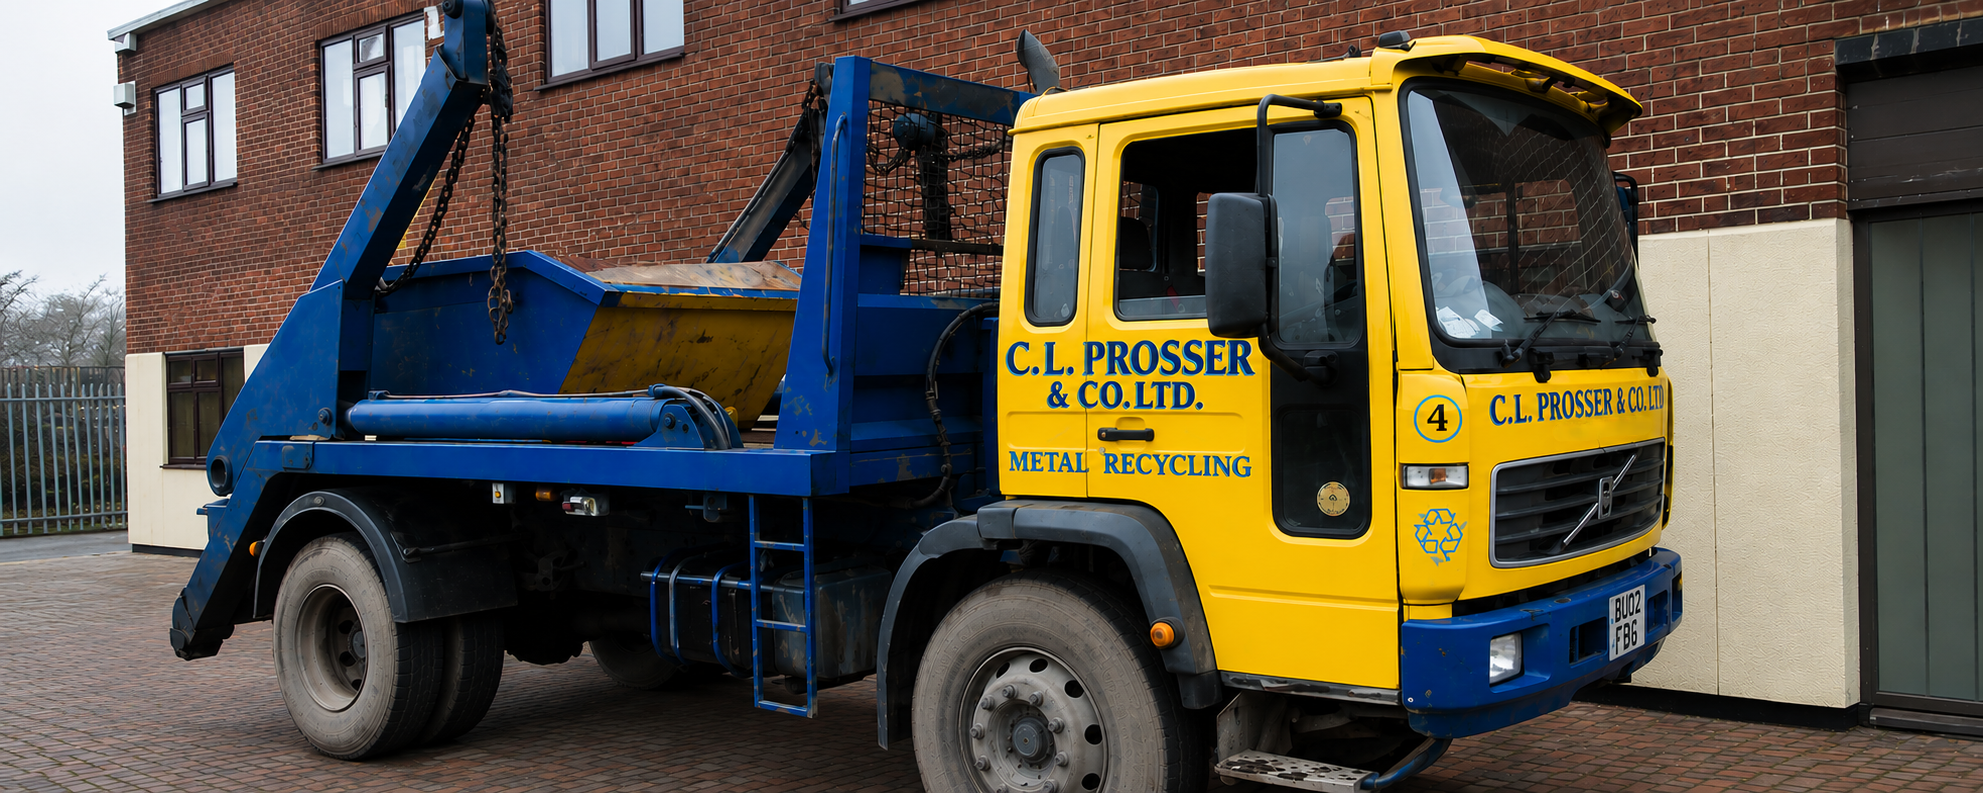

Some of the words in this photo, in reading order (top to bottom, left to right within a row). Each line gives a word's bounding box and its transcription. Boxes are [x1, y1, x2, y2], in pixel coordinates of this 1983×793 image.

[1082, 339, 1255, 376] PROSSER
[1047, 381, 1070, 409] &
[1536, 388, 1613, 422] PROSSER
[1617, 387, 1626, 414] &
[1427, 404, 1448, 431] 4
[1009, 451, 1089, 473] METAL
[1103, 453, 1252, 477] RECYCLING
[1615, 589, 1641, 623] BU02
